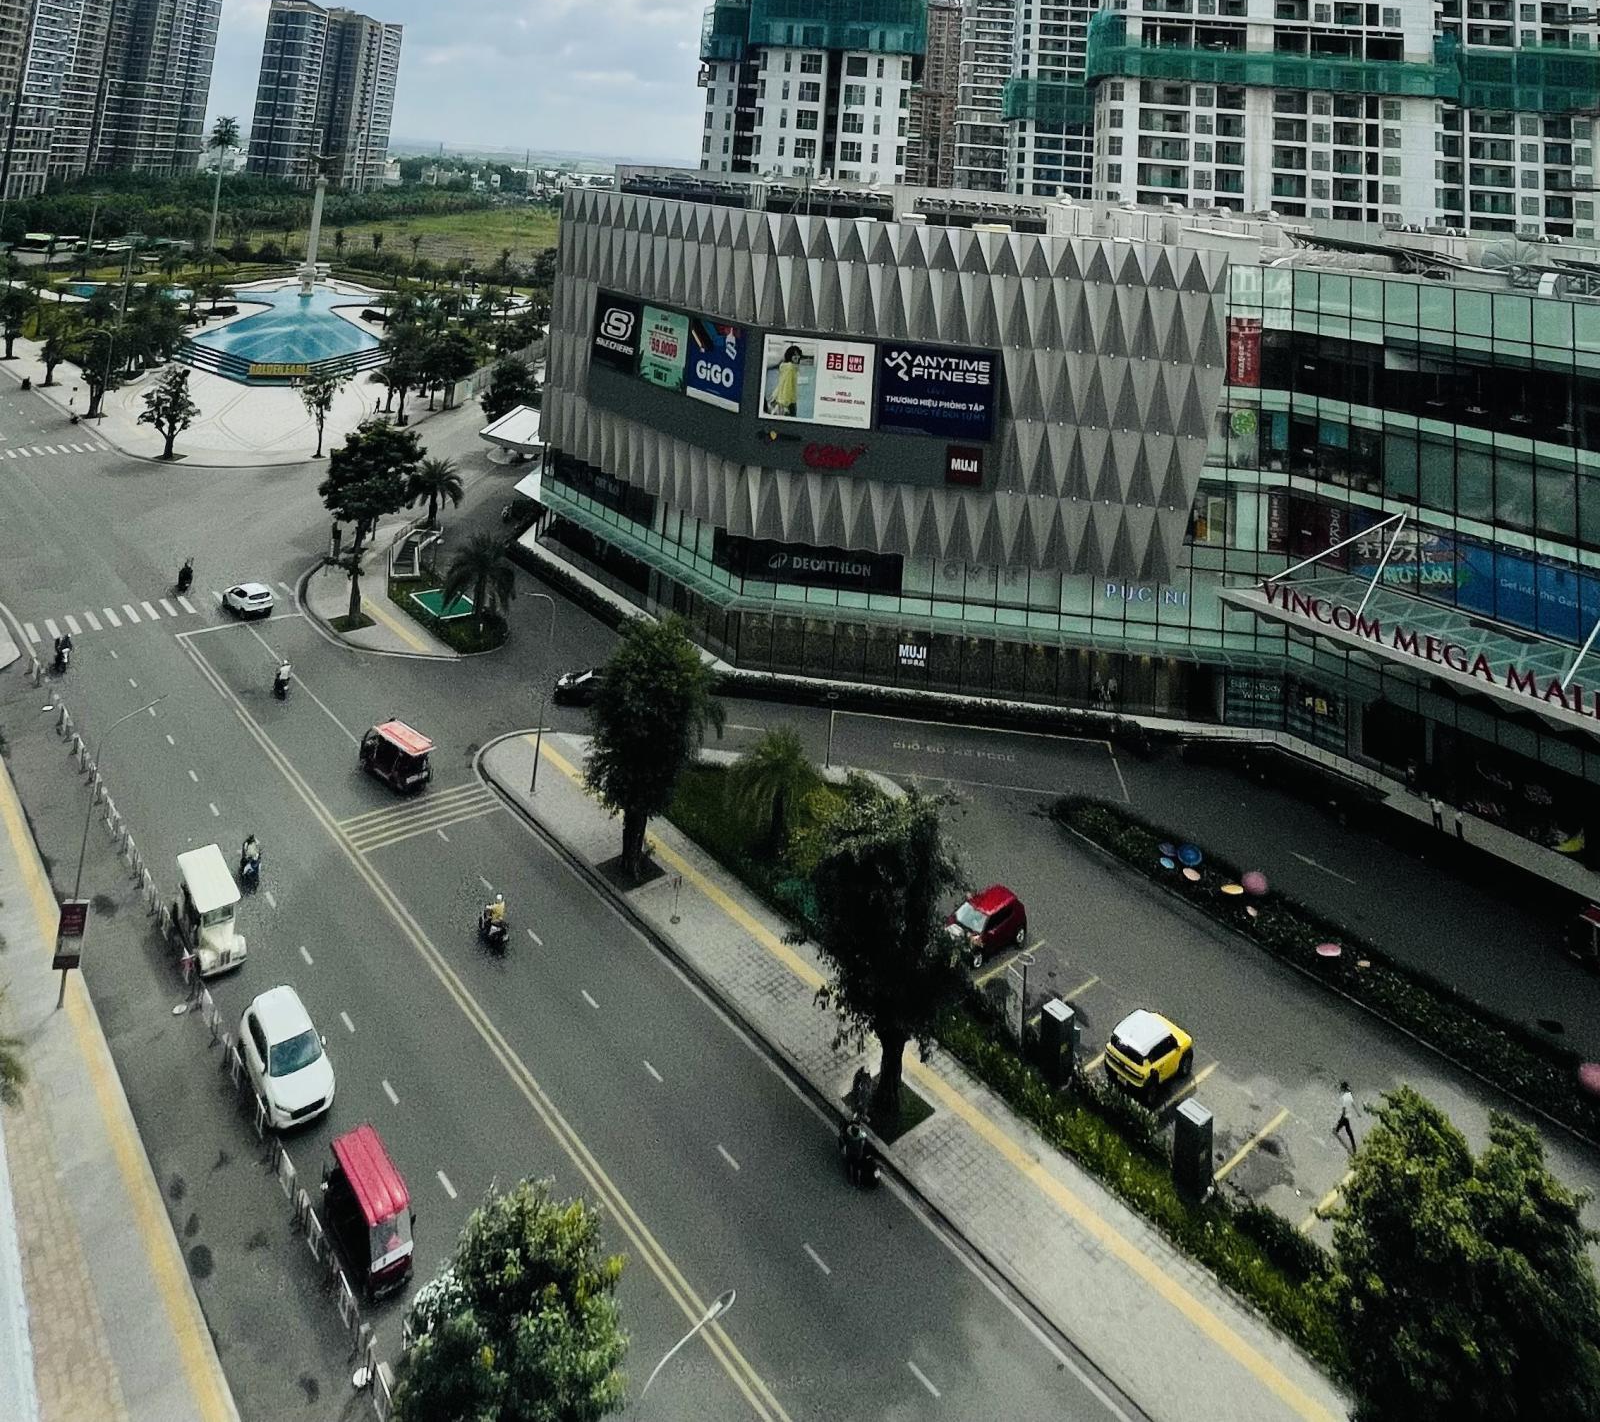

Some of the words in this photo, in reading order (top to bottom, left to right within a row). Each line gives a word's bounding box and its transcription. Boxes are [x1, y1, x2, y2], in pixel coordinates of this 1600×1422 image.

[595, 336, 635, 355] SKECHERS
[696, 359, 734, 388] GiGO
[913, 355, 990, 373] ANYTIME
[912, 367, 990, 385] FITNESS
[950, 457, 978, 473] MUJI
[792, 556, 871, 577] DECATHLON
[1106, 583, 1186, 606] PUCNI
[1261, 579, 1383, 644] VINCOM
[1393, 625, 1496, 684] MEGA
[899, 644, 927, 659] MUJI
